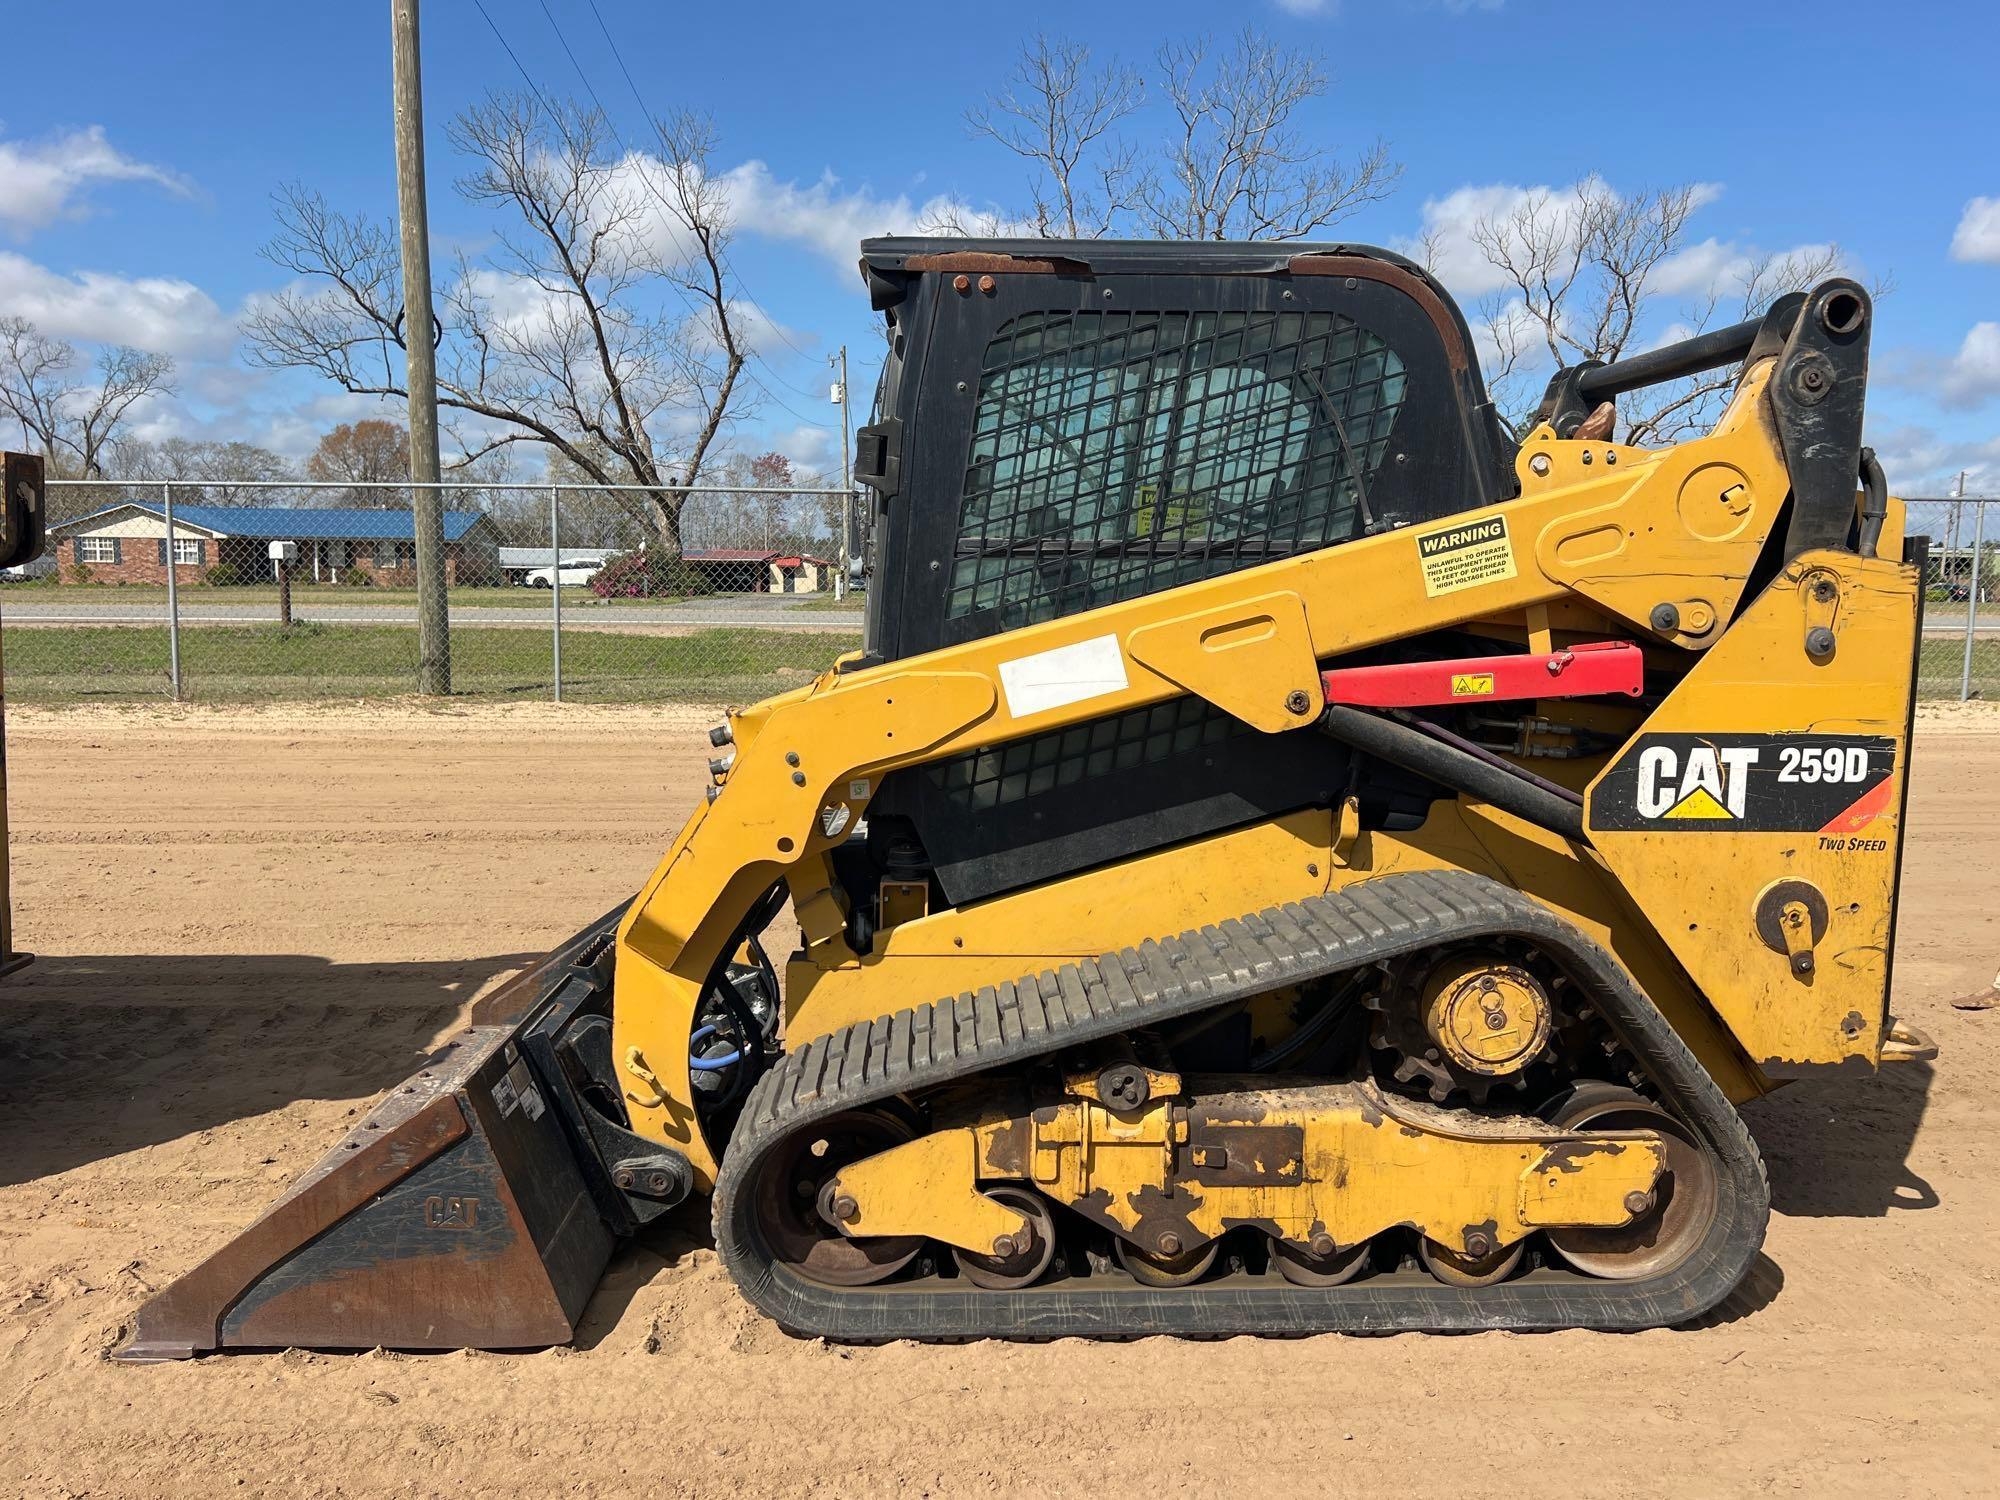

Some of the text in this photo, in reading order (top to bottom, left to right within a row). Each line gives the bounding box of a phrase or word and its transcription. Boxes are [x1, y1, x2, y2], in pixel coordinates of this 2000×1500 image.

[1145, 493, 1203, 506] WNING
[1423, 523, 1501, 552] WARNING
[1427, 556, 1463, 570] UNLAWFUL
[1475, 545, 1506, 557] OPERATE
[1427, 552, 1509, 577] THIS EQUIPMENT WITHIN
[1442, 571, 1459, 580] FEET
[1470, 560, 1507, 573] OVERHEAD
[1436, 567, 1506, 589] HIGH VOLTAGE LINES
[1637, 746, 1869, 819] CAT 259D
[1819, 837, 1887, 851] TWO SPEED
[425, 1196, 480, 1229] CAT
